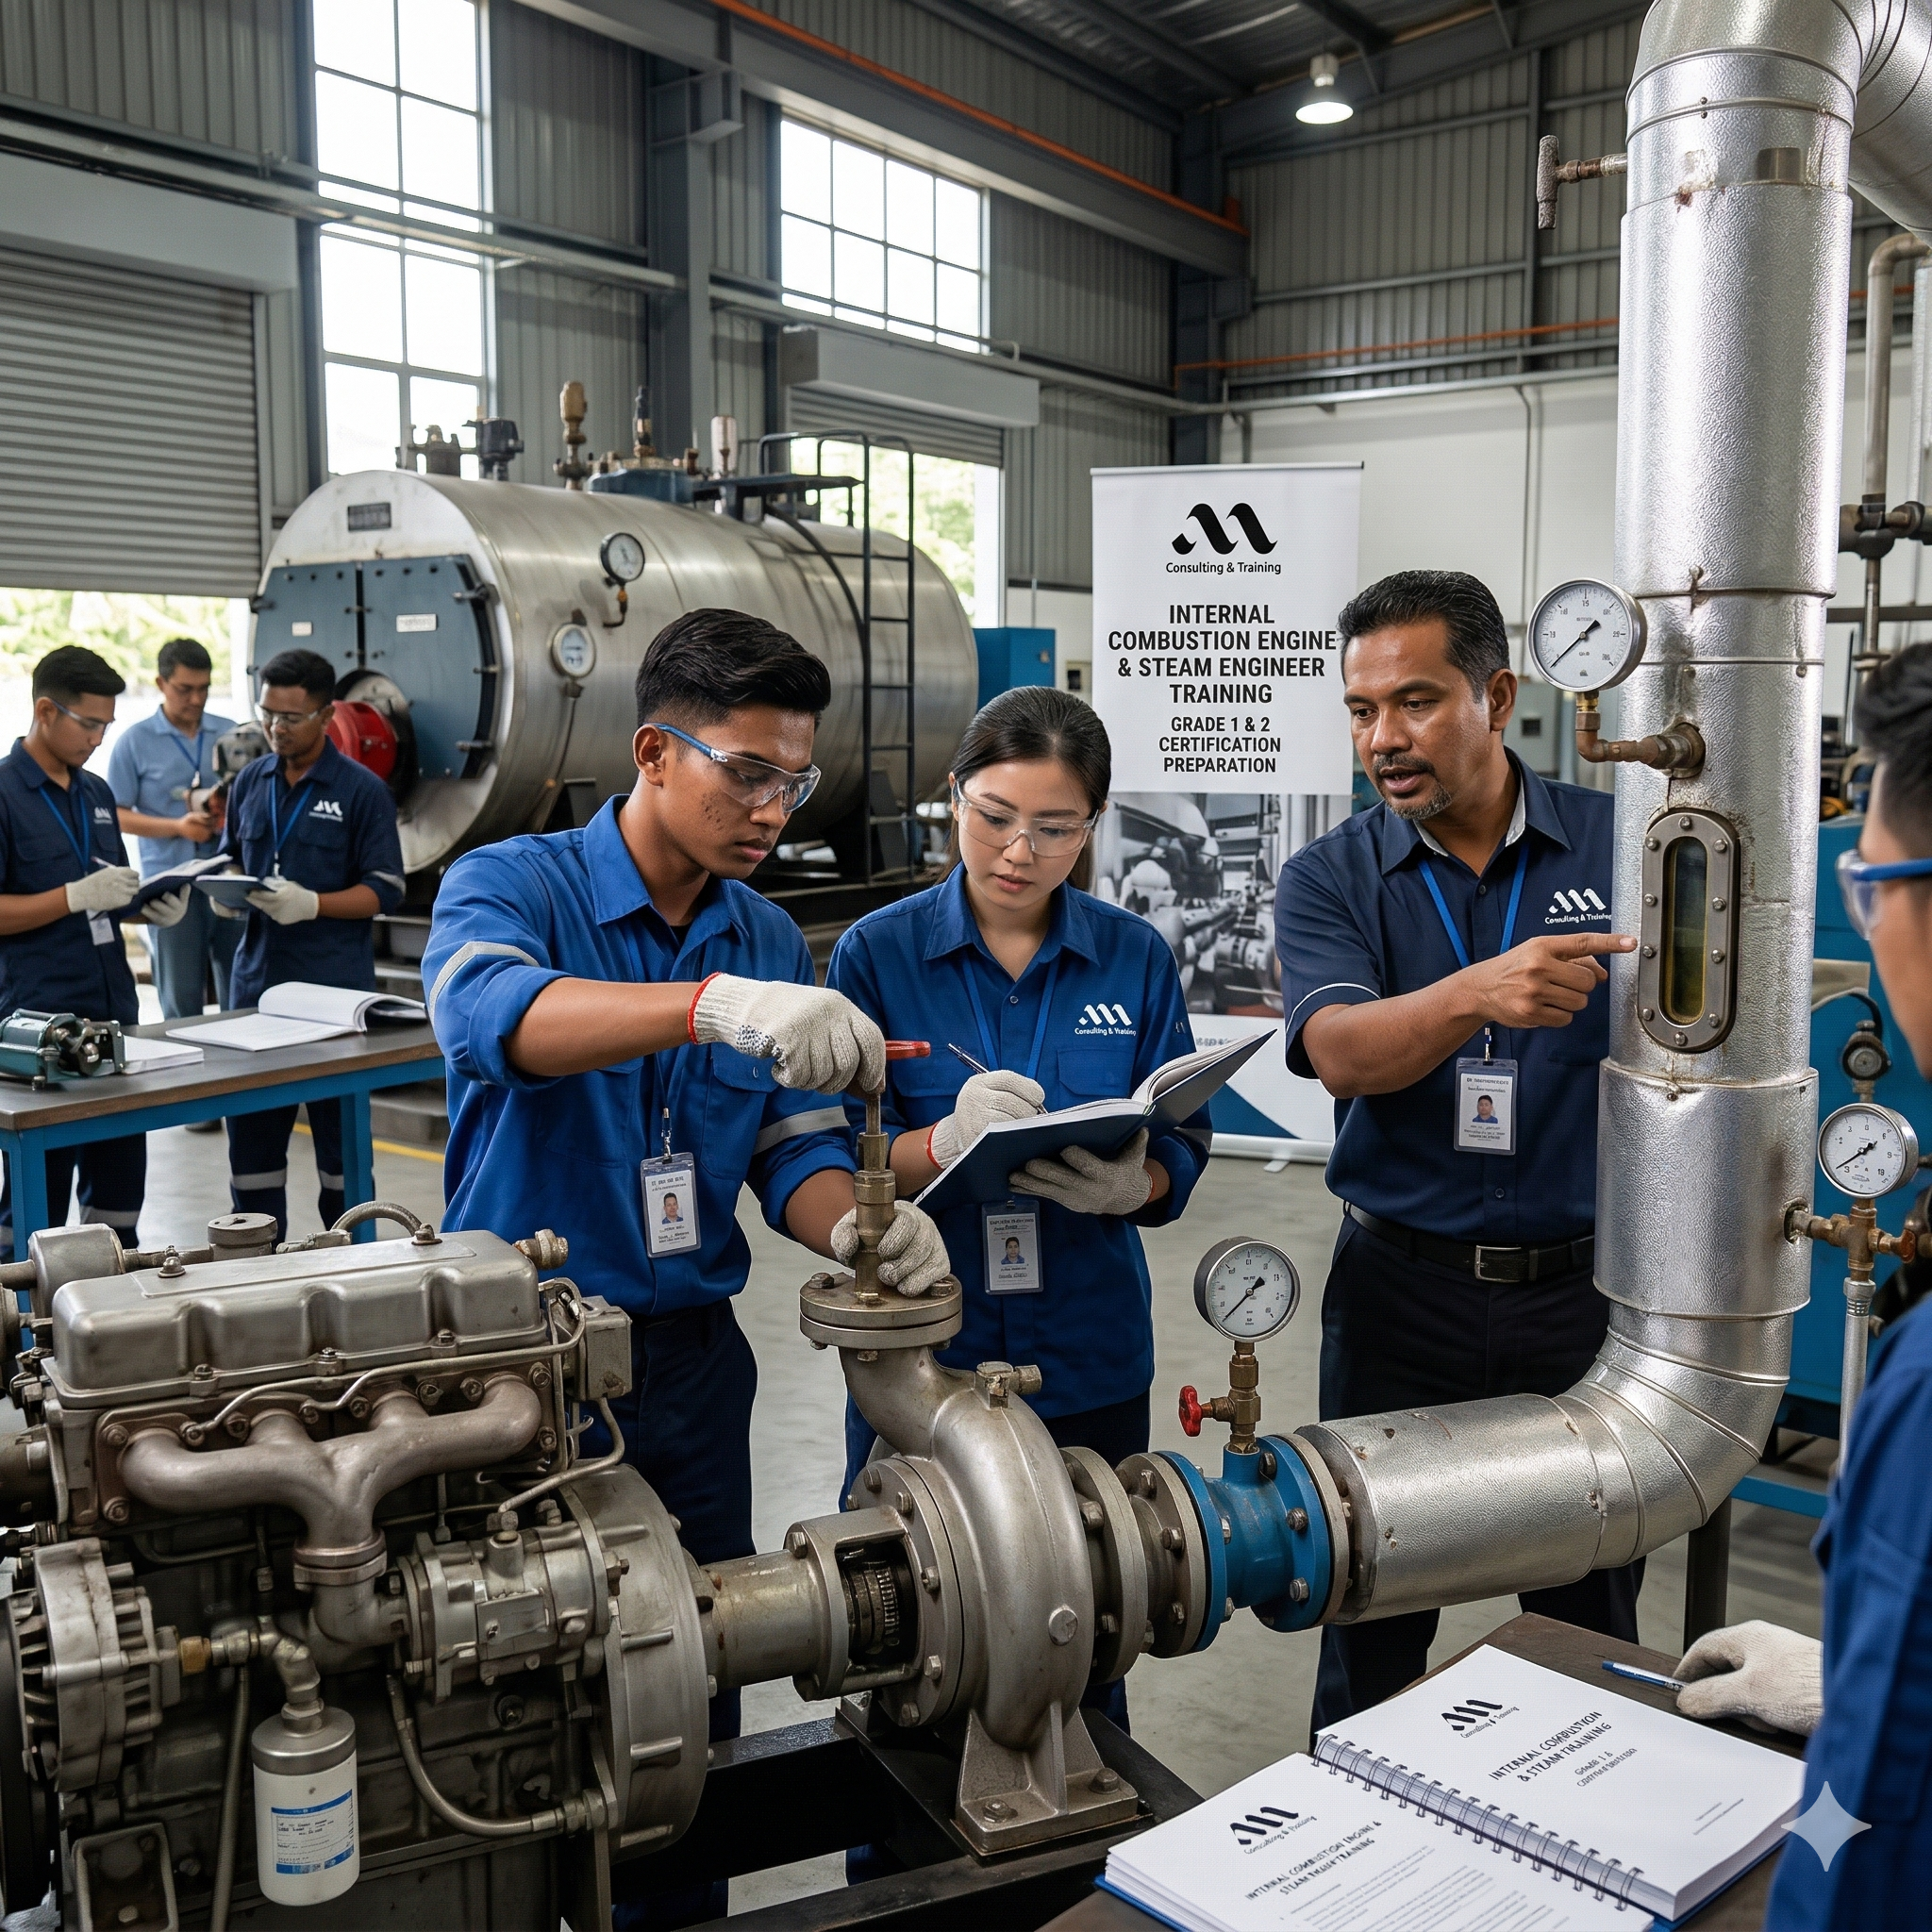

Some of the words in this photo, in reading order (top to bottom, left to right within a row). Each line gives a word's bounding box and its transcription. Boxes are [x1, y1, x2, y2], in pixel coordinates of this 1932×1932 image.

[1166, 562, 1224, 575] Consulting
[1226, 563, 1235, 573] &
[1237, 562, 1281, 575] Training
[1170, 605, 1274, 624] INTERNAL
[1108, 631, 1250, 650] COMBUSTION
[1257, 631, 1337, 650] ENGINE
[1118, 658, 1132, 677] &
[1139, 658, 1212, 676] STEAM
[1219, 658, 1325, 676] ENGINEER
[1169, 684, 1273, 704] TRAINING
[1171, 717, 1225, 732] GRADE
[1230, 717, 1238, 731] 1
[1244, 717, 1256, 732] &
[1260, 717, 1271, 731] 2
[1158, 737, 1281, 752] CERTIFICATION
[1163, 758, 1276, 773] PREPARATION
